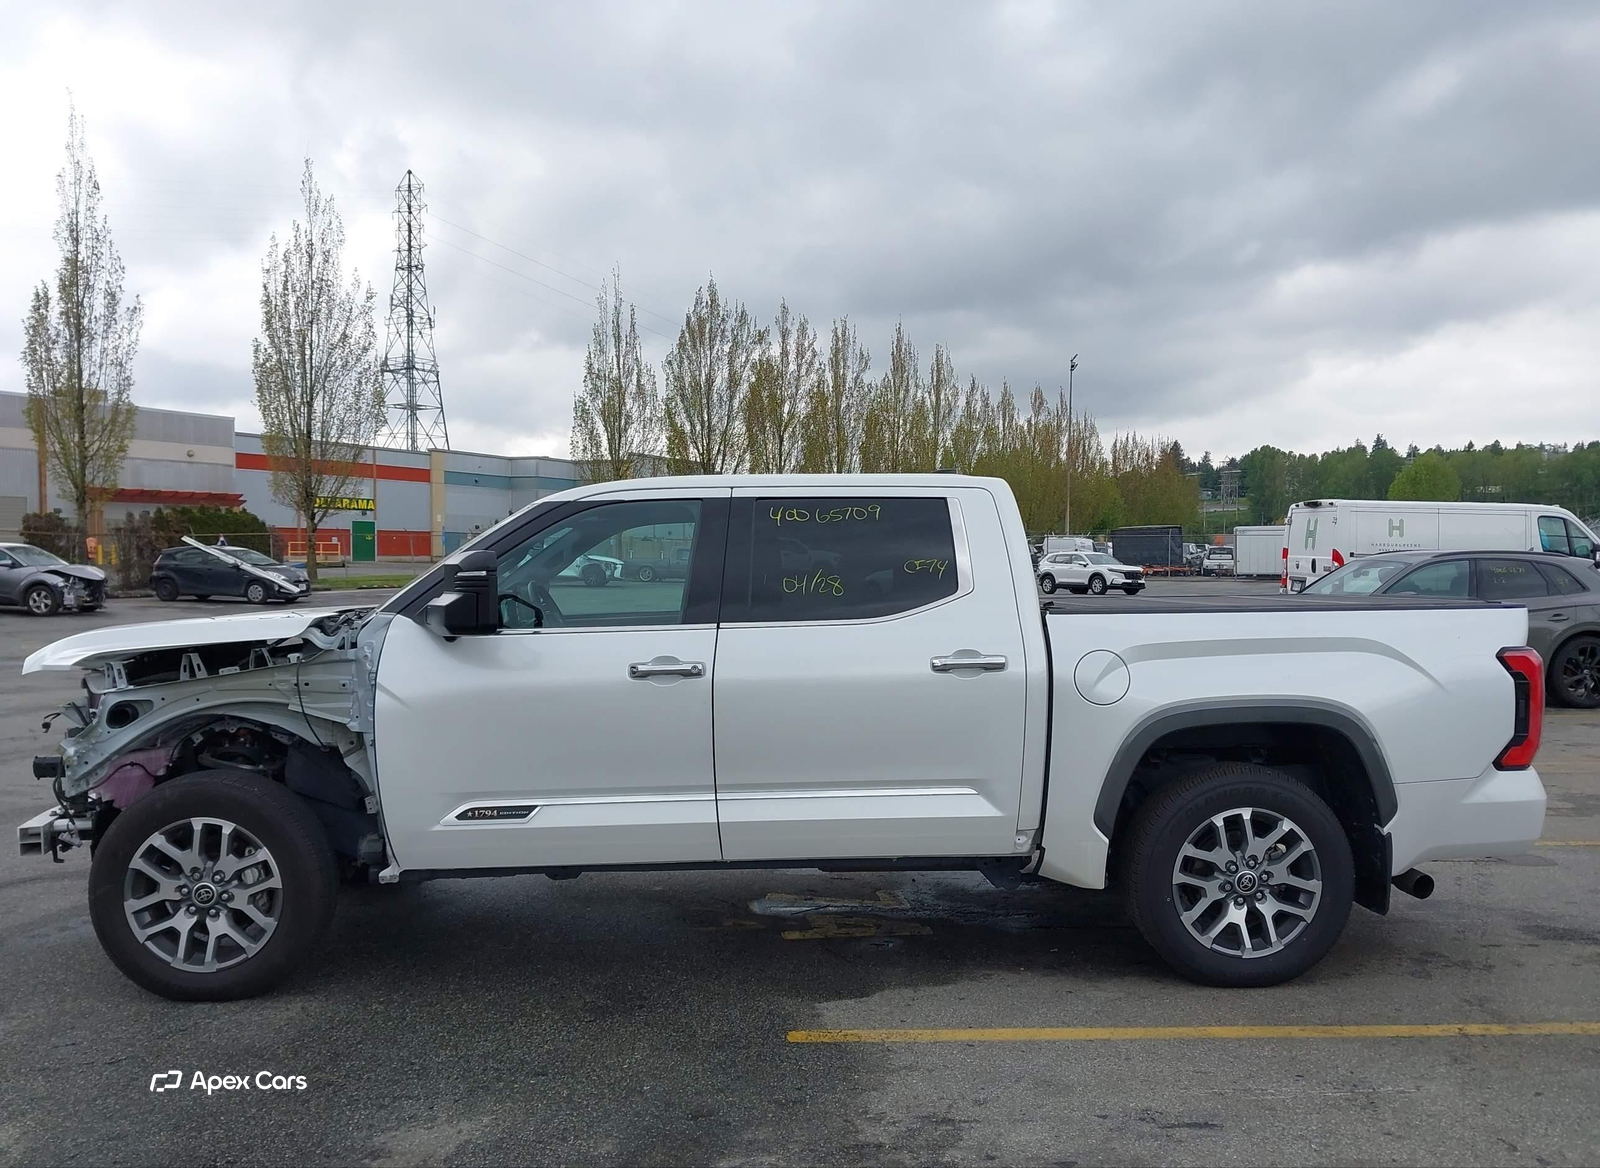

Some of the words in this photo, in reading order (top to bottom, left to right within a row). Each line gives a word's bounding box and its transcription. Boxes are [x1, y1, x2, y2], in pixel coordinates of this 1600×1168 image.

[1304, 517, 1319, 551] H
[1388, 518, 1404, 538] H
[782, 569, 844, 596] 04/28
[474, 809, 498, 818] 1794
